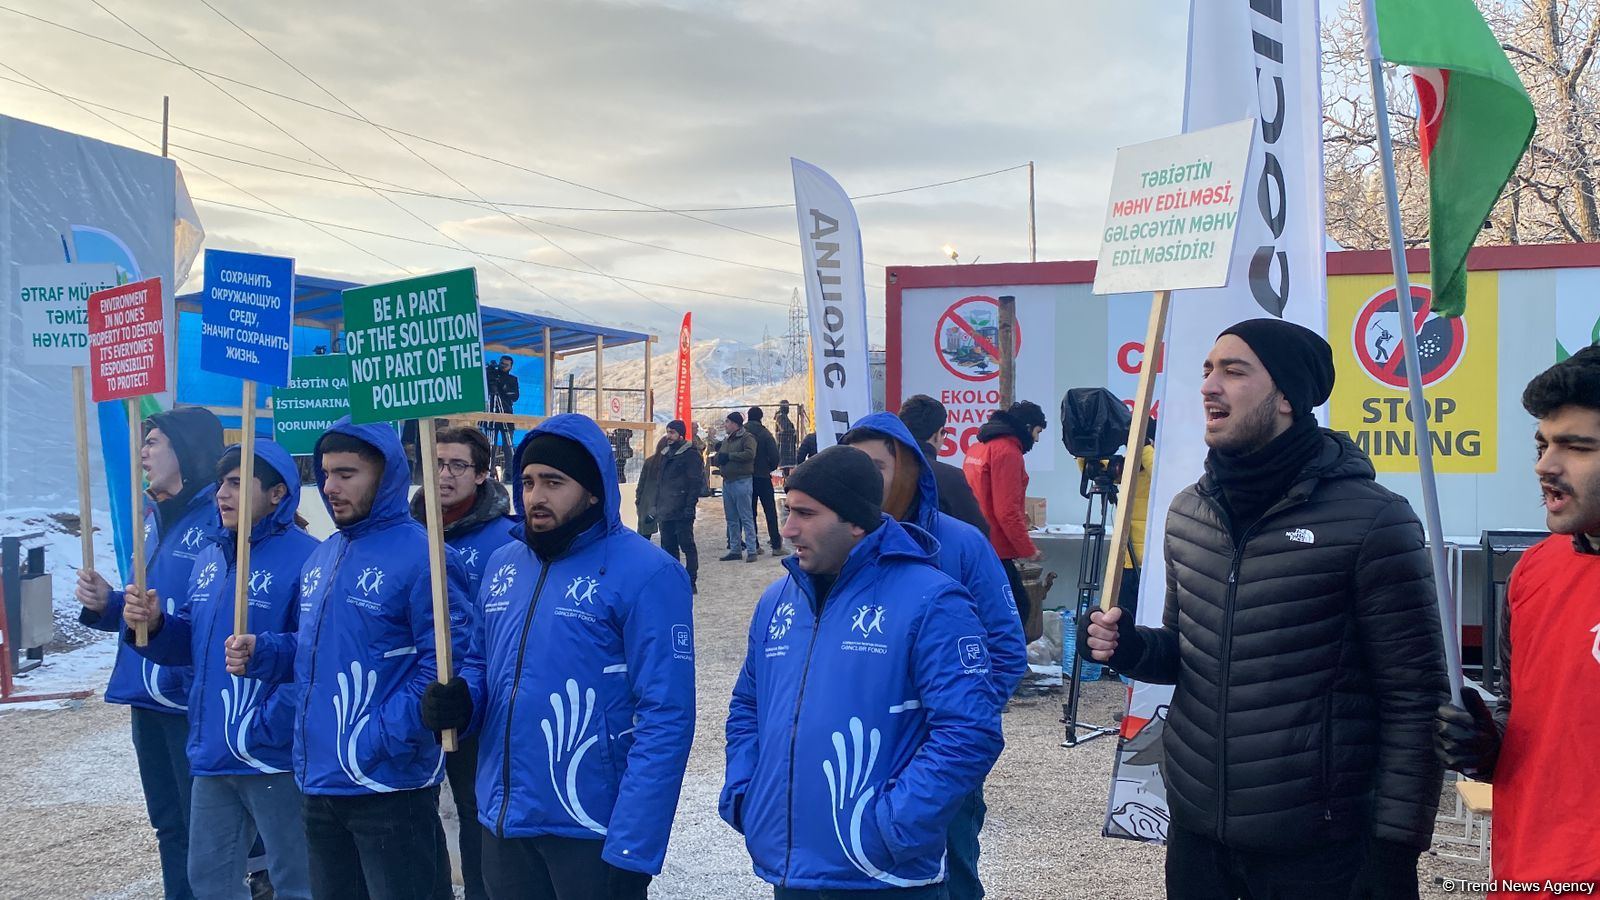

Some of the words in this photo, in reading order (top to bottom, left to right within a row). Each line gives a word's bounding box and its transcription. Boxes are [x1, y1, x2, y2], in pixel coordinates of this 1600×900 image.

[1141, 159, 1213, 189] TƏBİƏTİN
[1112, 197, 1153, 218] MƏHV
[1155, 180, 1234, 212] EDİLMƏSİ,
[1104, 215, 1185, 243] GƏLƏCƏYİN
[1189, 211, 1237, 234] MƏHV
[1112, 239, 1215, 267] EDİLMƏSİDİR!
[220, 269, 272, 288] СОХРАНИТЬ
[21, 287, 64, 302] ƏTRAF
[100, 289, 148, 314] ENVIRONMENT
[211, 287, 280, 309] ОКРУЖАЮЩУЮ
[373, 296, 392, 323] BE
[396, 294, 406, 319] A
[408, 286, 447, 317] PART
[114, 312, 123, 326] NO
[125, 307, 145, 323] ONE'S
[229, 309, 259, 328] СРЕДУ,
[89, 328, 120, 347] PROPERTY
[121, 326, 130, 340] TO
[202, 322, 235, 340] ЗНАЧИТ
[236, 329, 289, 350] СОХРАНИТЬ
[346, 330, 365, 355] OF
[367, 325, 396, 352] THE
[100, 346, 113, 361] IT'S
[114, 338, 154, 358] EVERYONE'S
[226, 346, 260, 364] ЖИЗНЬ.
[100, 354, 155, 377] RESPONSIBILITY
[352, 356, 381, 383] NOT
[385, 350, 423, 379] PART
[427, 346, 447, 374] OF
[450, 342, 481, 370] THE
[107, 377, 116, 391] TO
[117, 372, 149, 390] PROTECT!
[277, 377, 329, 389] BİƏTİN
[372, 375, 462, 410] POLLUTION!
[276, 398, 350, 410] İSTİSMARINA
[1362, 397, 1457, 423] STOP
[1339, 430, 1480, 456] MINNG
